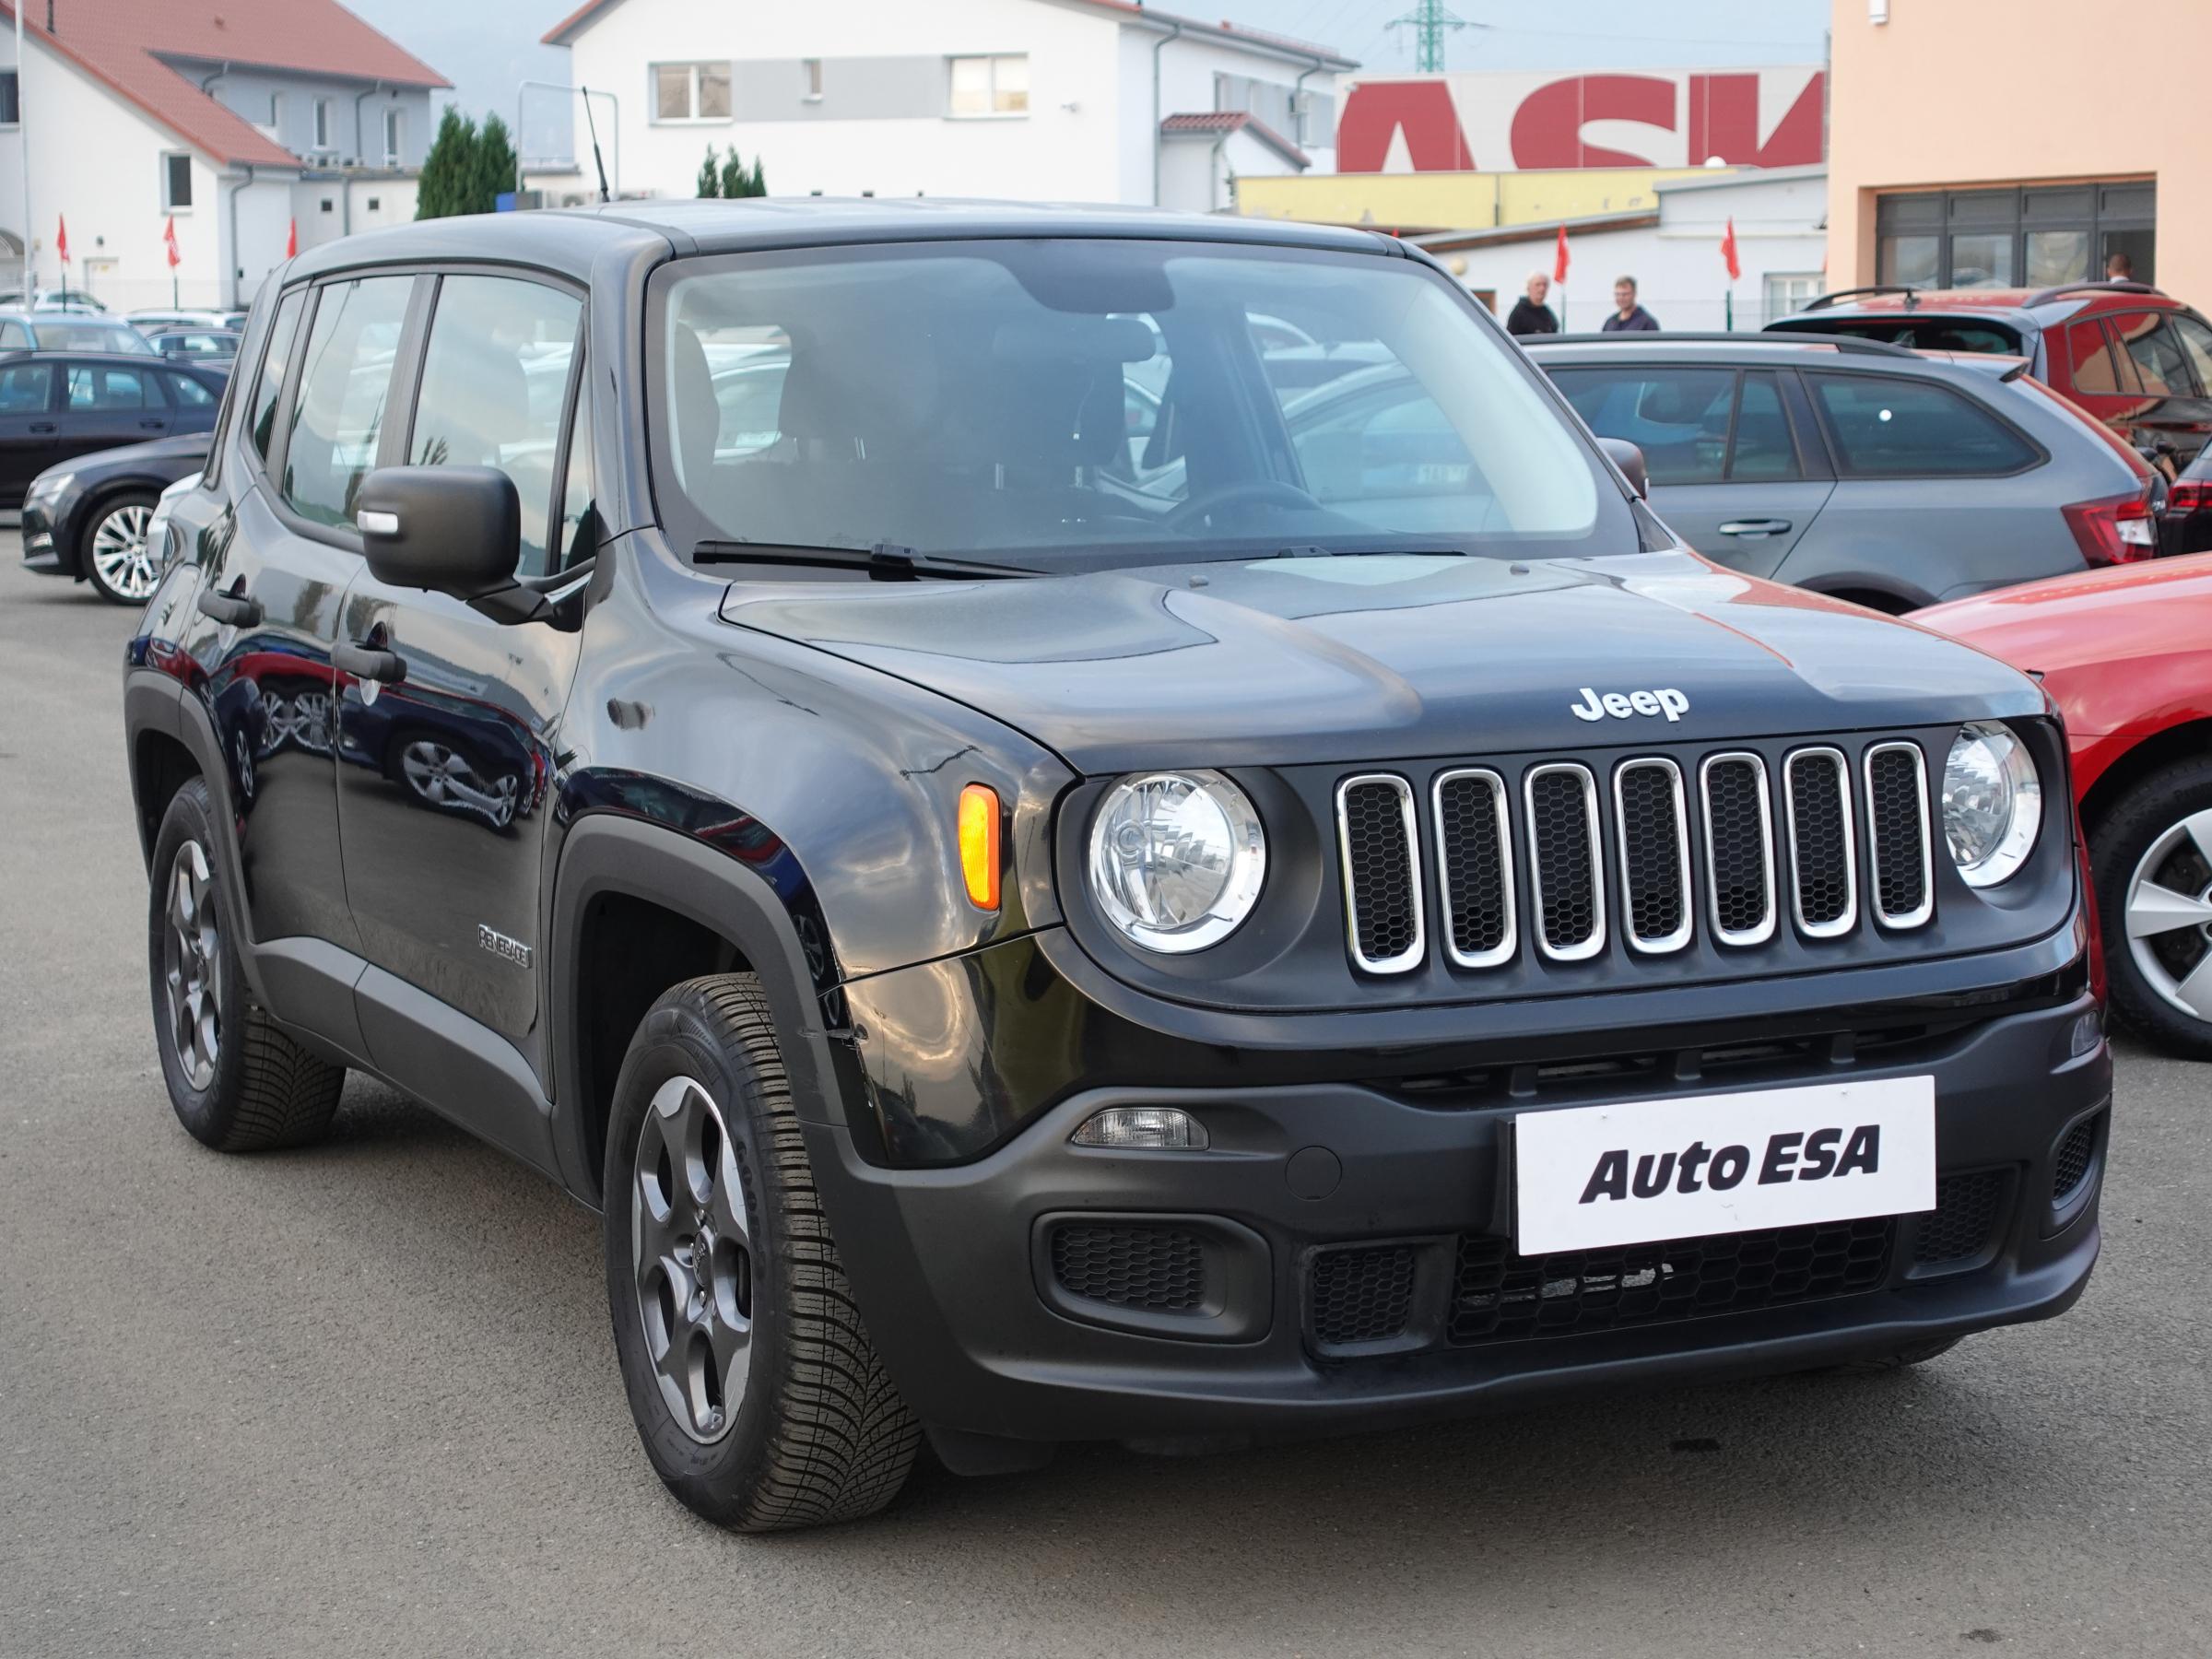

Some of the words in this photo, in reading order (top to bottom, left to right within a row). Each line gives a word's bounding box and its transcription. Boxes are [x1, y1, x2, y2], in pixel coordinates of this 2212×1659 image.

[1571, 688, 1690, 723] Jeep
[1578, 1141, 1750, 1204] Auto
[1758, 1124, 1880, 1185] ESA
